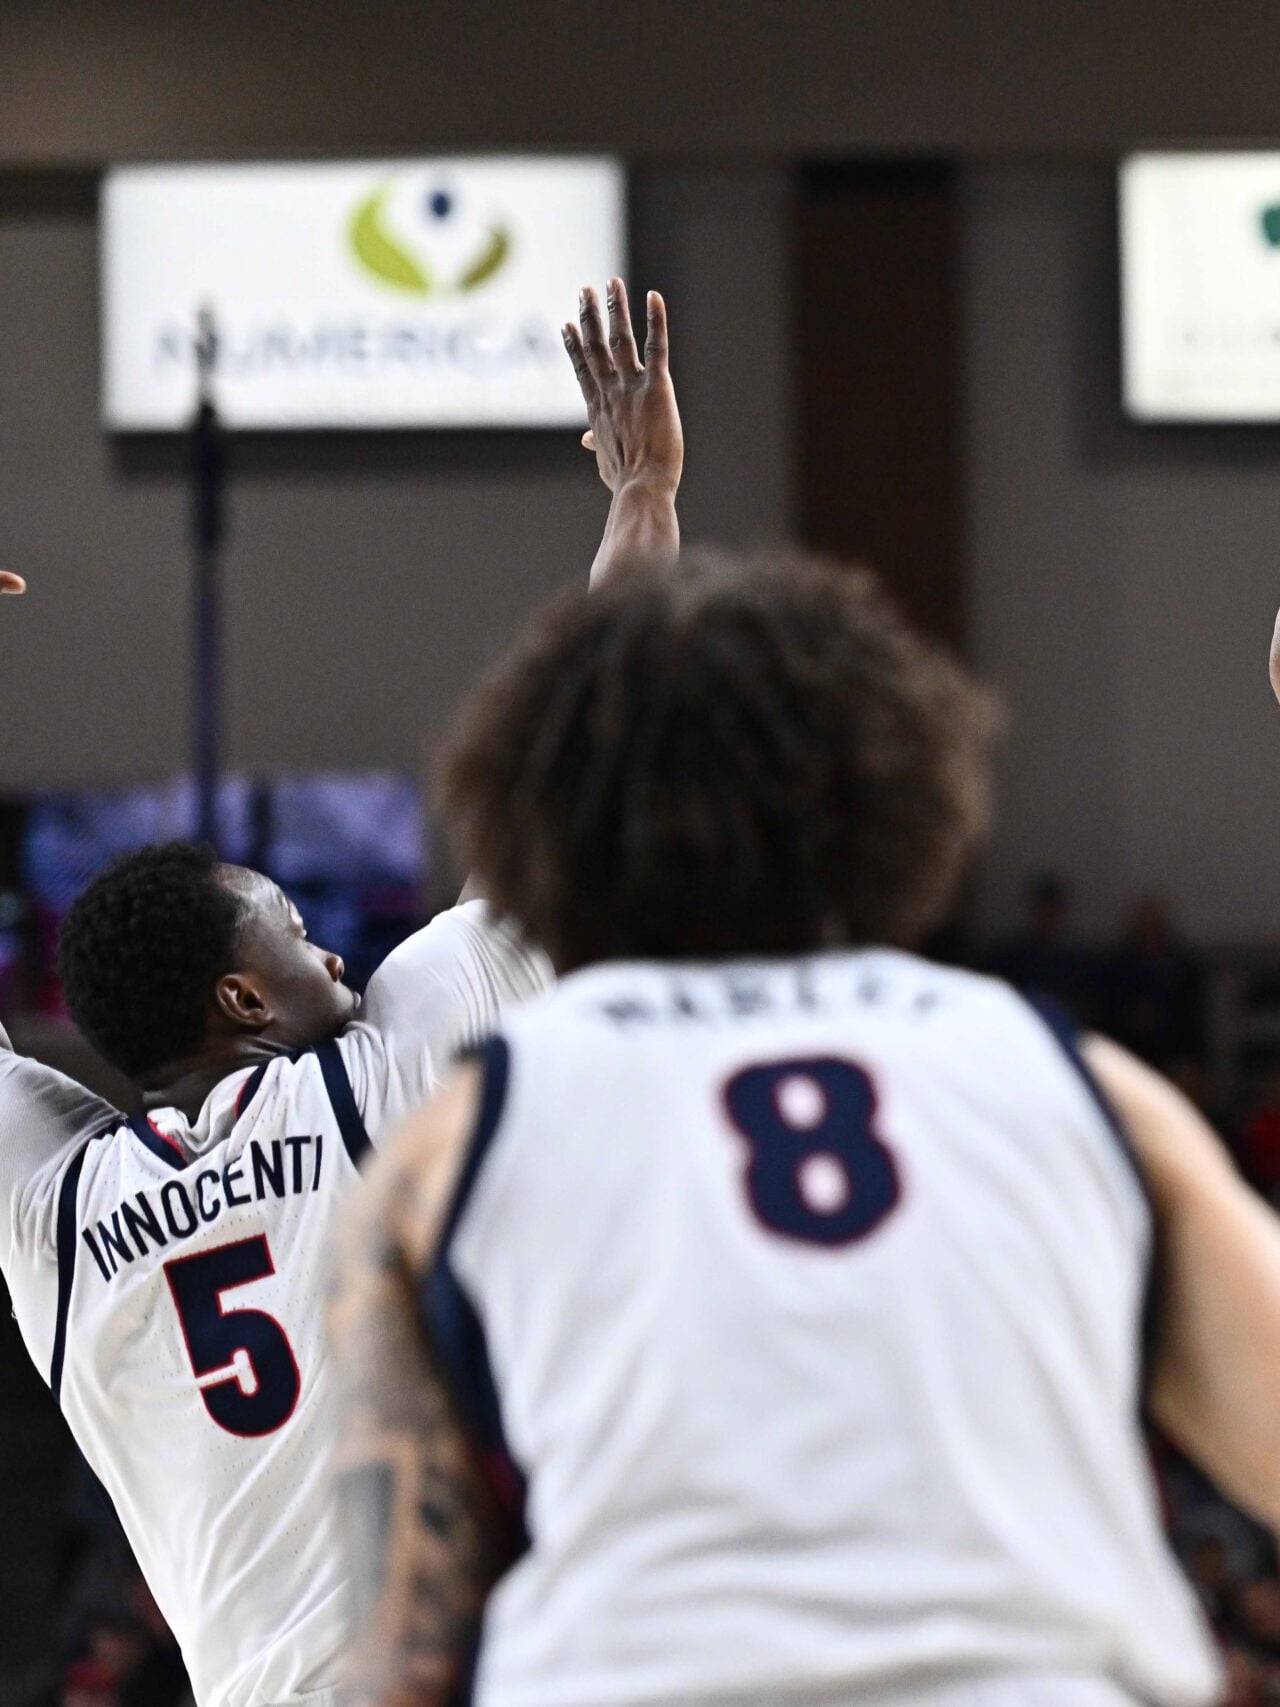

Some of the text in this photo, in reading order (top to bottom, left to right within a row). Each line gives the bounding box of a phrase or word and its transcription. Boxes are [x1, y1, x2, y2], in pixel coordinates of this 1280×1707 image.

[82, 1135, 323, 1282] INNOCENTI
[722, 1053, 904, 1247] 8
[163, 1233, 300, 1438] 5
